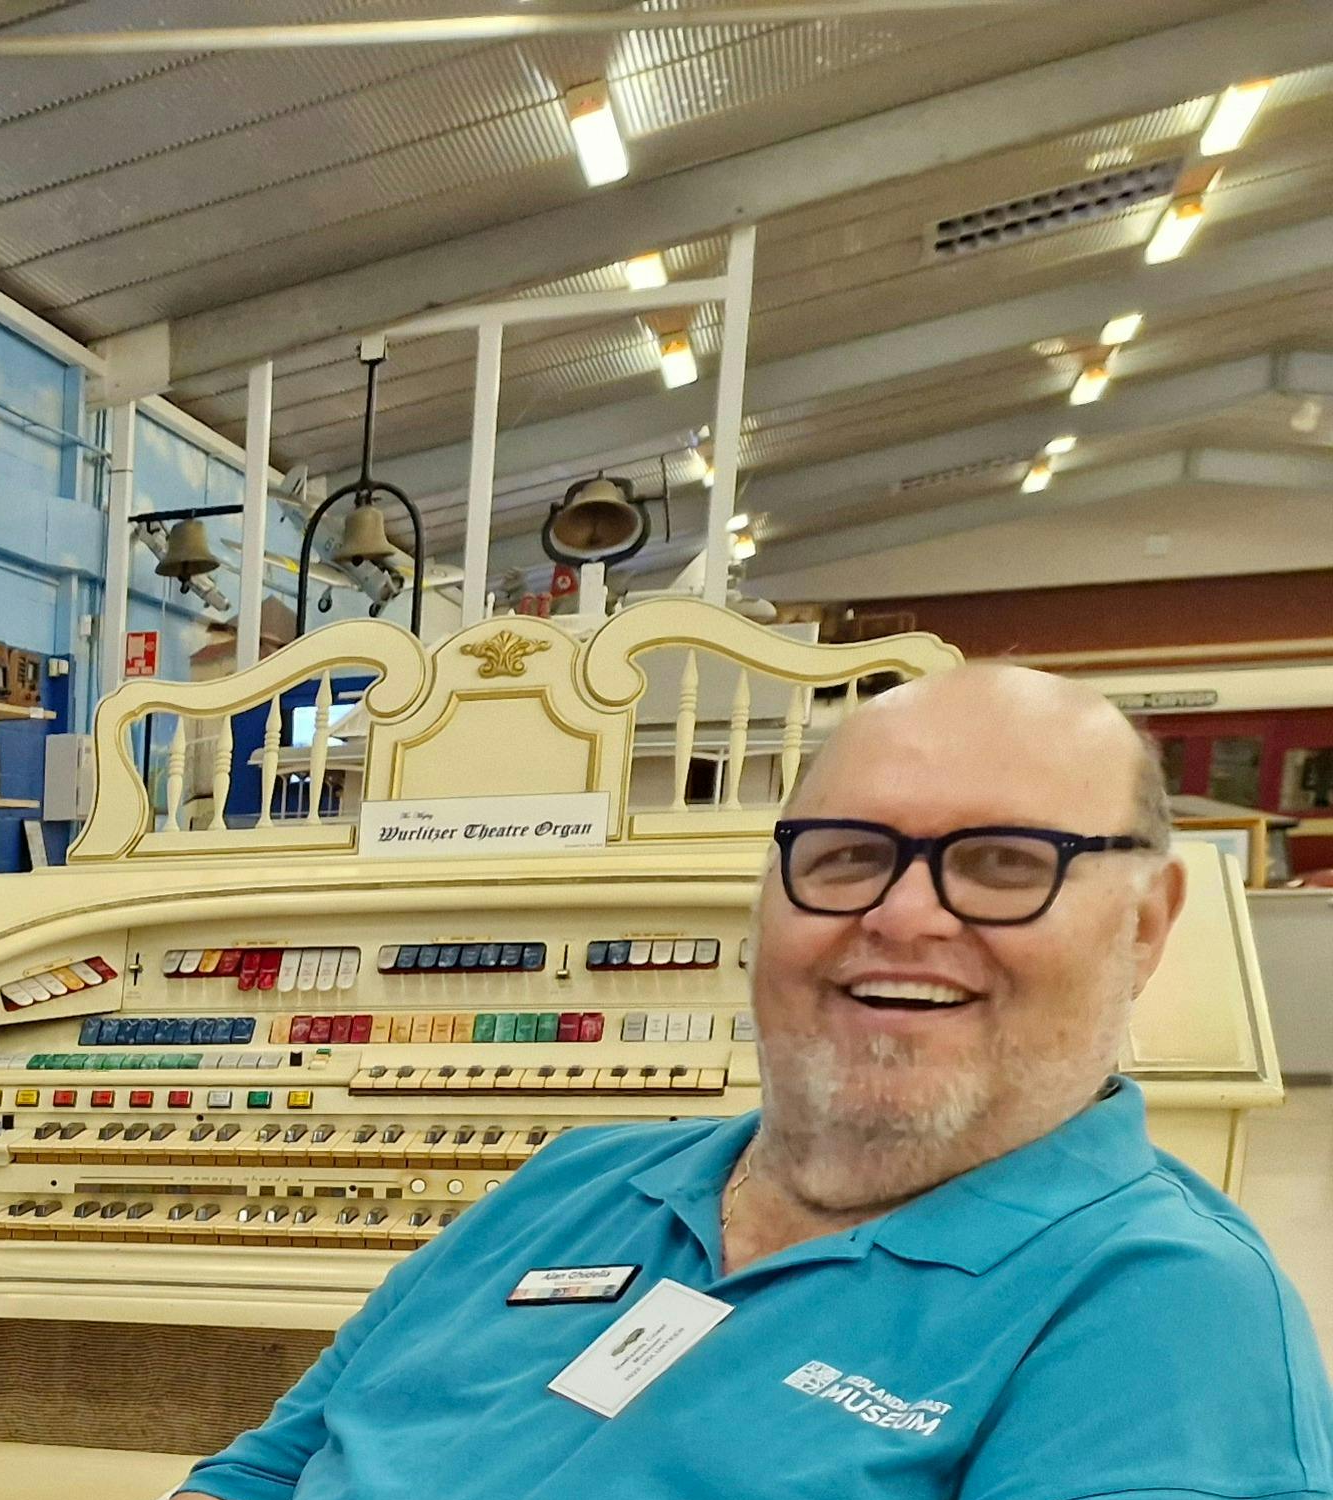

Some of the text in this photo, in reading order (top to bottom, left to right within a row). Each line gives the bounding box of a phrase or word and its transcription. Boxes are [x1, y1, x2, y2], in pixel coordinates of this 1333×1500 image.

[379, 820, 593, 843] Wurlitzer Theatre Organ
[820, 1383, 941, 1437] MUSEUM
